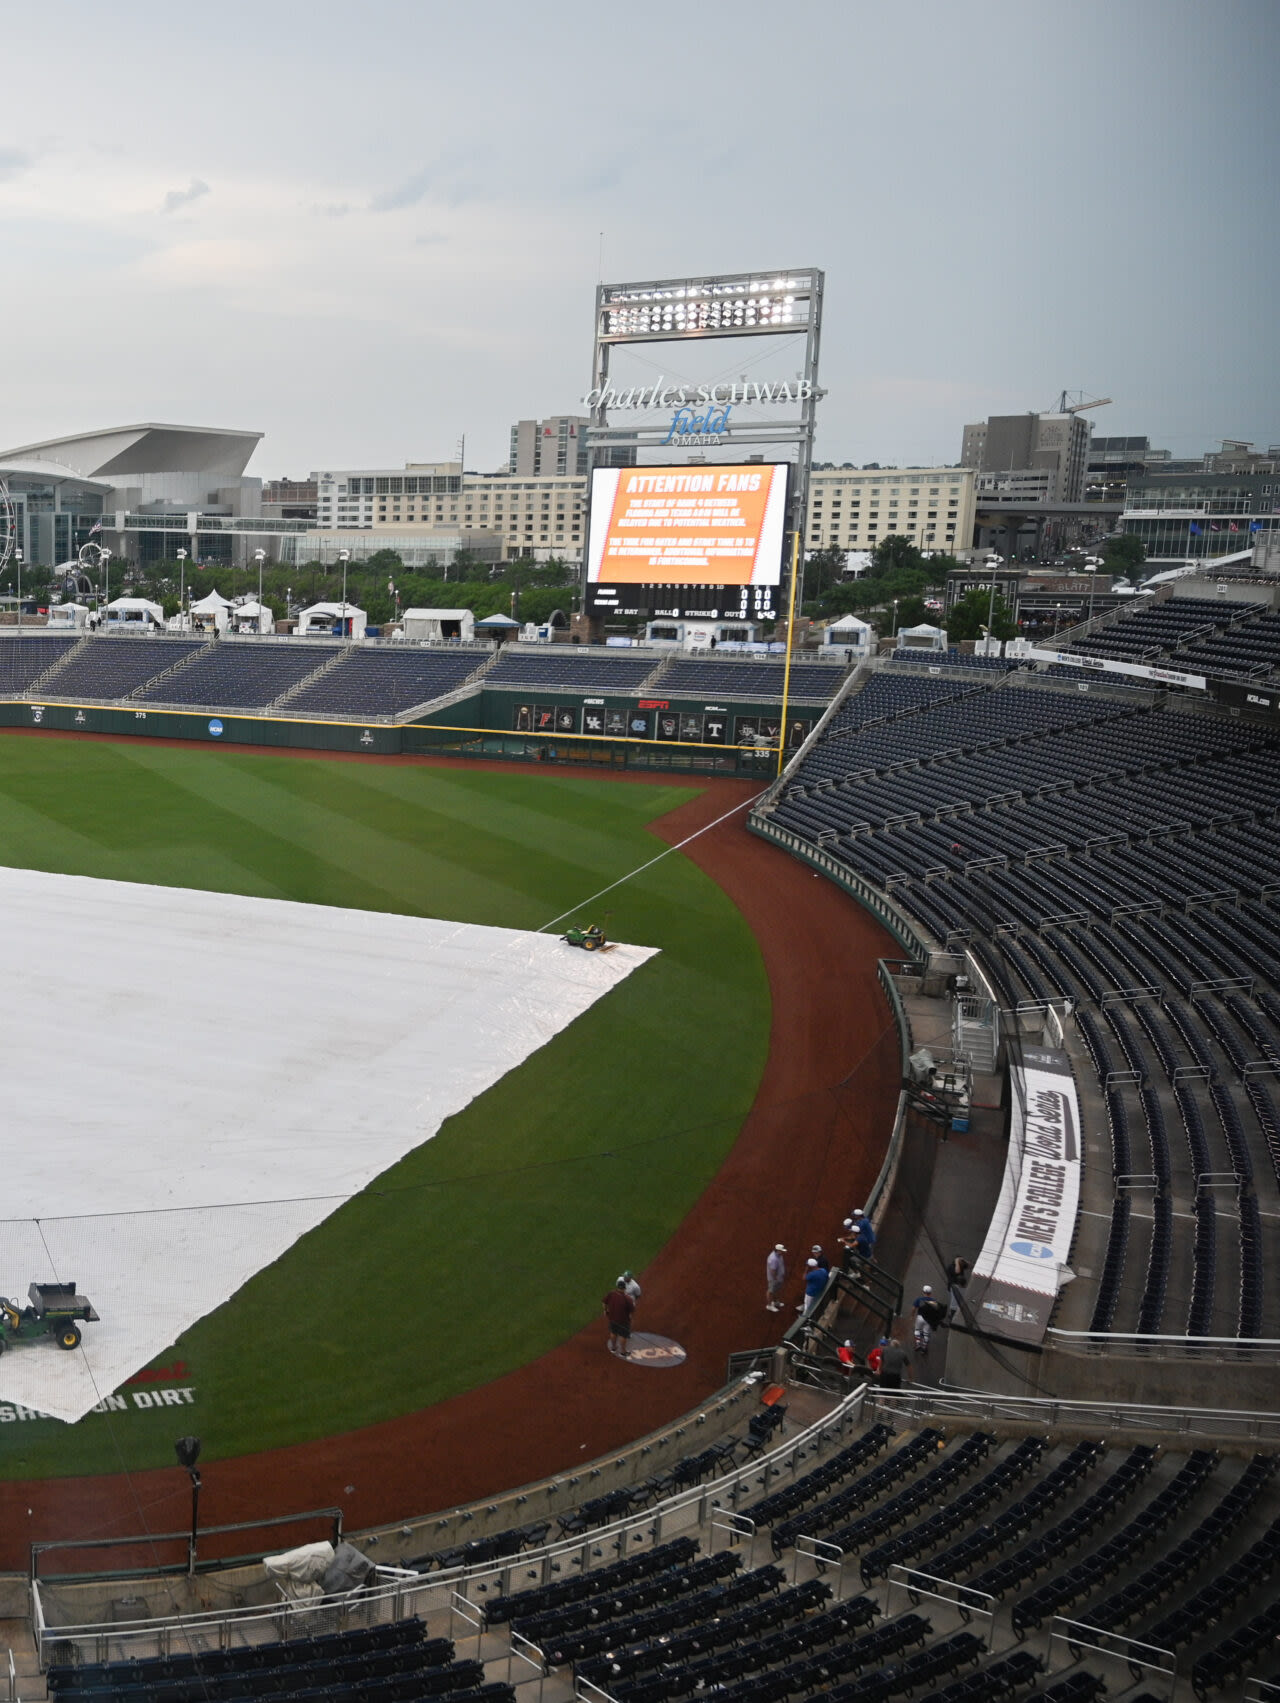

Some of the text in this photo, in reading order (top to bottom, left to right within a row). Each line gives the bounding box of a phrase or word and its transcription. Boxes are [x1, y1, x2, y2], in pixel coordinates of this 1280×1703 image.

[584, 375, 812, 409] charles SCHWAB
[661, 405, 732, 444] field
[671, 433, 721, 446] OMAHA
[626, 473, 762, 493] ATTENTION FANS
[740, 600, 748, 610] 0
[754, 600, 761, 610] 0
[764, 600, 770, 610] 0
[742, 590, 748, 600] 0
[755, 590, 762, 600] 0
[764, 590, 771, 600] 0
[672, 608, 678, 617] 0
[739, 610, 746, 618] 0
[638, 700, 670, 710] ESPN
[708, 723, 722, 736] T
[1026, 1089, 1063, 1126] Series
[1025, 1122, 1062, 1161] World
[1025, 1160, 1066, 1208] COLLEGE
[1015, 1207, 1060, 1244] MEN'S
[132, 1387, 195, 1409] DIRT
